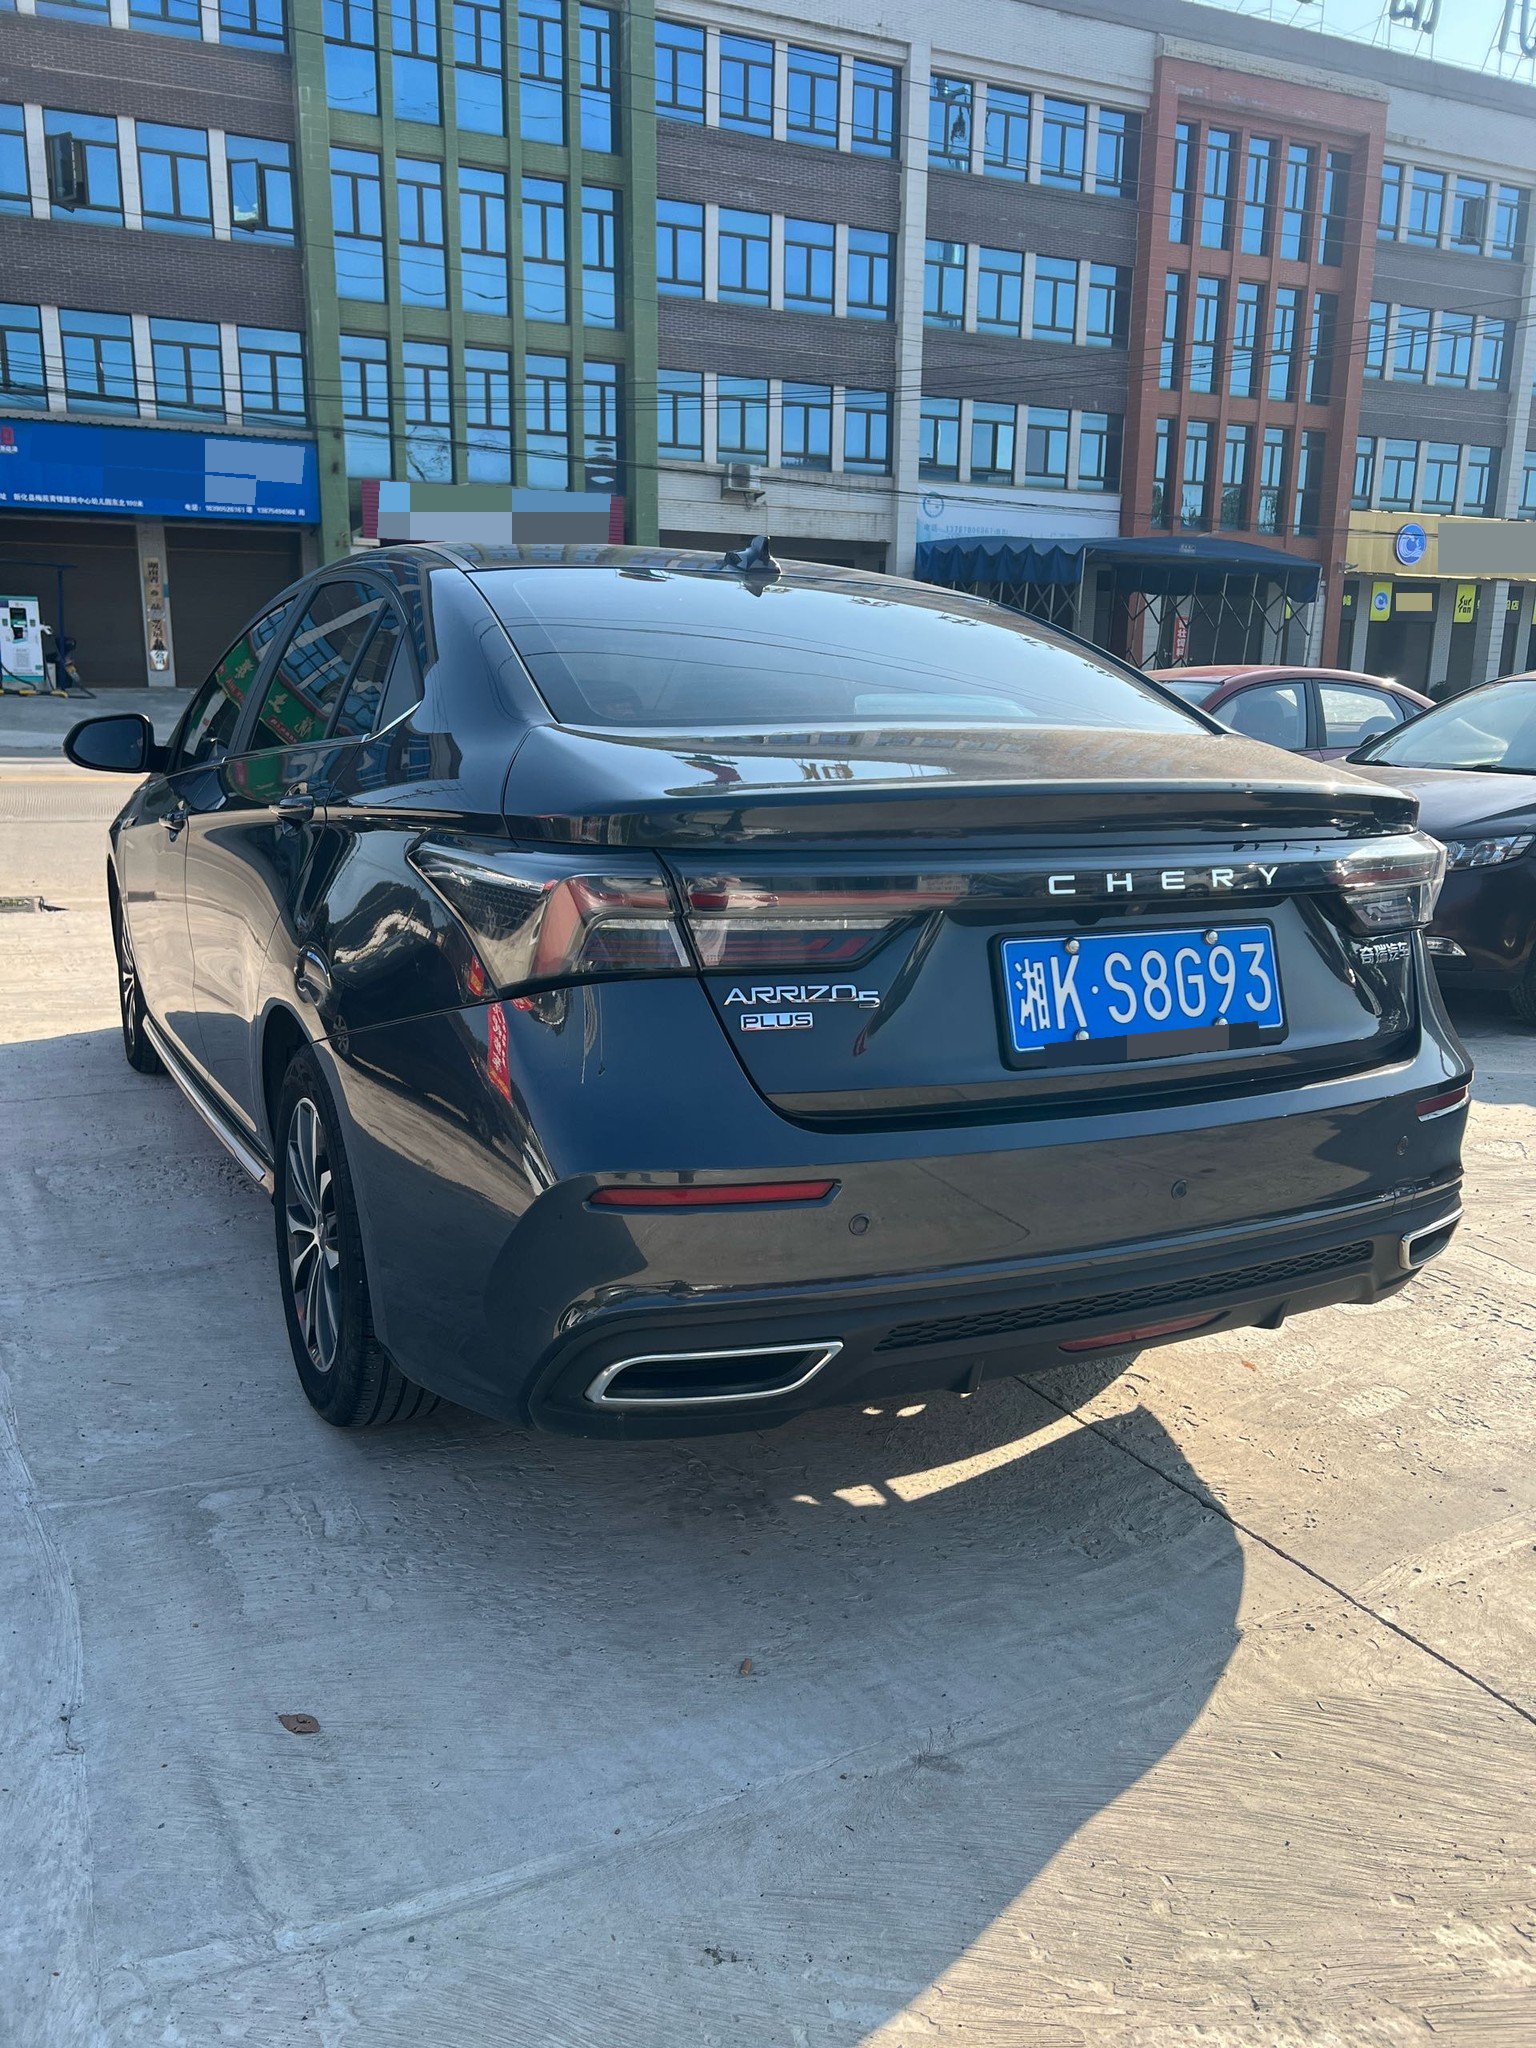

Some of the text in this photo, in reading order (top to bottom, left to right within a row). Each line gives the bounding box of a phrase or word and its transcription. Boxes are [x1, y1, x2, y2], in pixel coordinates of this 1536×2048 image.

[1048, 866, 1279, 896] CHERY
[1359, 941, 1411, 965] 奇瑞汽车
[742, 1014, 812, 1030] PLUS
